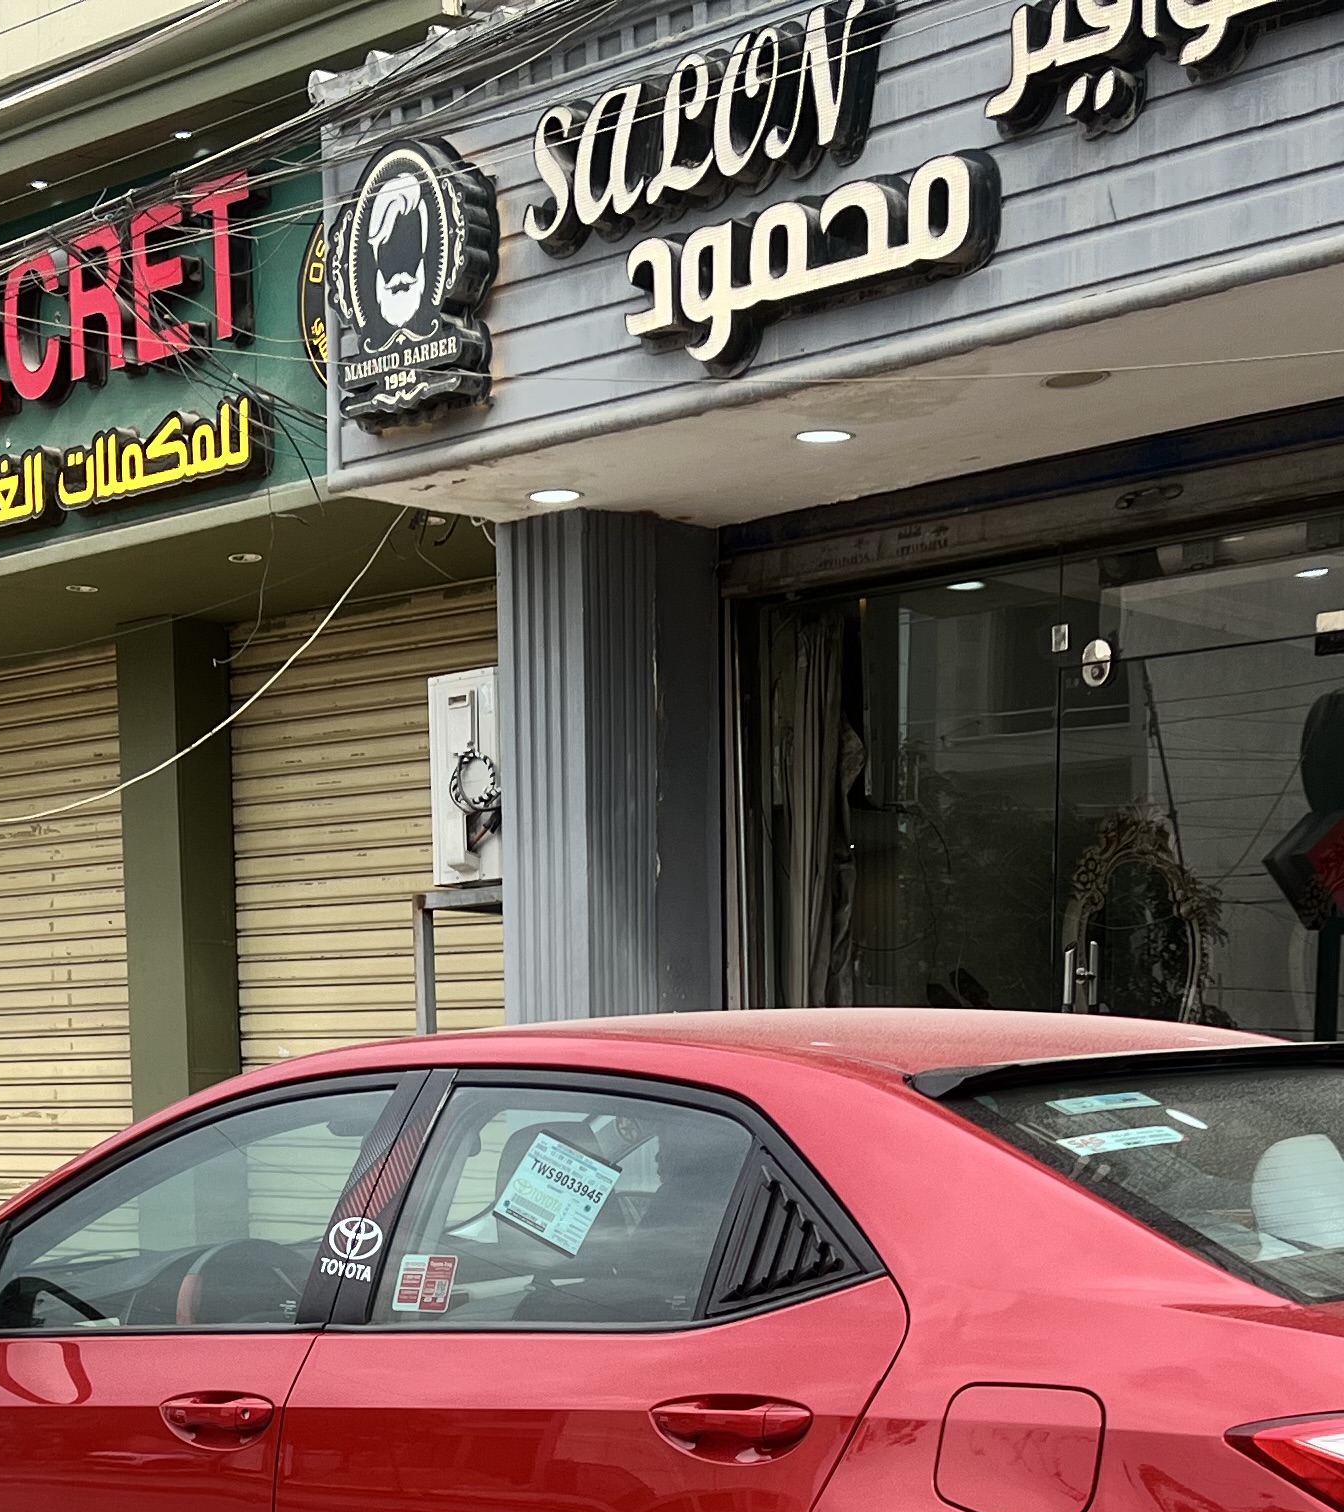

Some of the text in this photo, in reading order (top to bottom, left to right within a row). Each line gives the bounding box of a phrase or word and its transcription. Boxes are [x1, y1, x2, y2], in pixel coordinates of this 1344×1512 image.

[523, 0, 864, 241] SALON
[625, 155, 970, 362] محمود
[344, 335, 458, 383] MAHMUD BARBER
[384, 368, 417, 391] 1994
[58, 396, 250, 507] للمكملات
[529, 1157, 604, 1204] TWS9033945
[320, 1257, 372, 1282] TOYOTA
